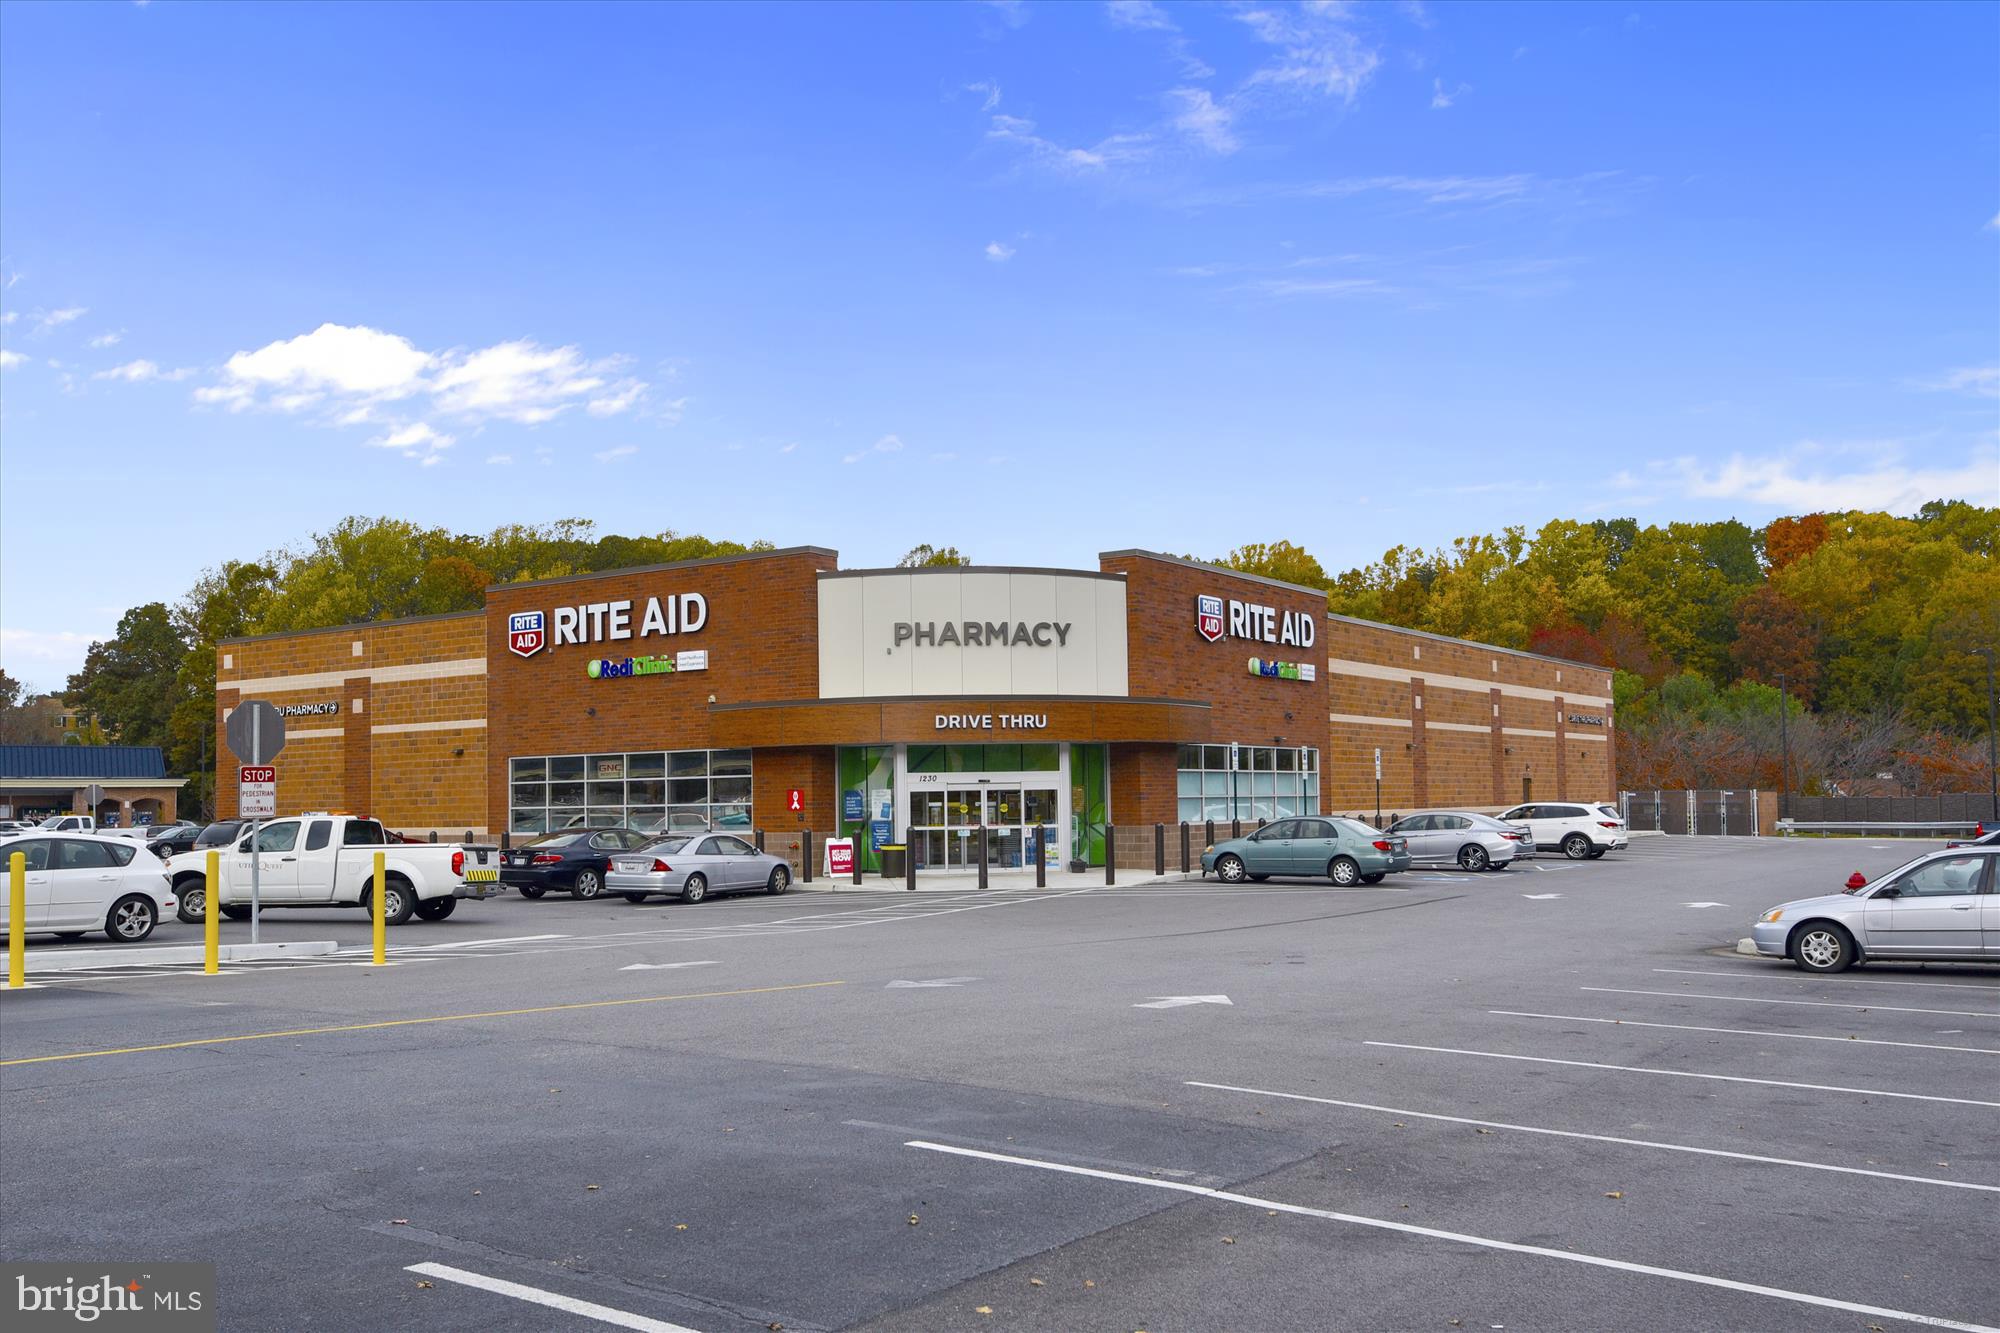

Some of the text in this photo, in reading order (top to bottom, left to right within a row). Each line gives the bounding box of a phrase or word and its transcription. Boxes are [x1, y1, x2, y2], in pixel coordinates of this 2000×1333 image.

[1203, 599, 1220, 614] RITE
[514, 615, 538, 630] RITE
[554, 592, 707, 645] RITE AID
[1204, 618, 1219, 633] AID
[1229, 600, 1315, 648] RITE AID
[516, 633, 537, 648] AID
[894, 621, 1072, 647] PHARMACY
[600, 654, 674, 678] RediClinic
[286, 703, 329, 716] PHARMACY
[935, 714, 1047, 729] DRIVE THRU
[599, 763, 621, 772] GNC
[244, 770, 272, 781] STOP
